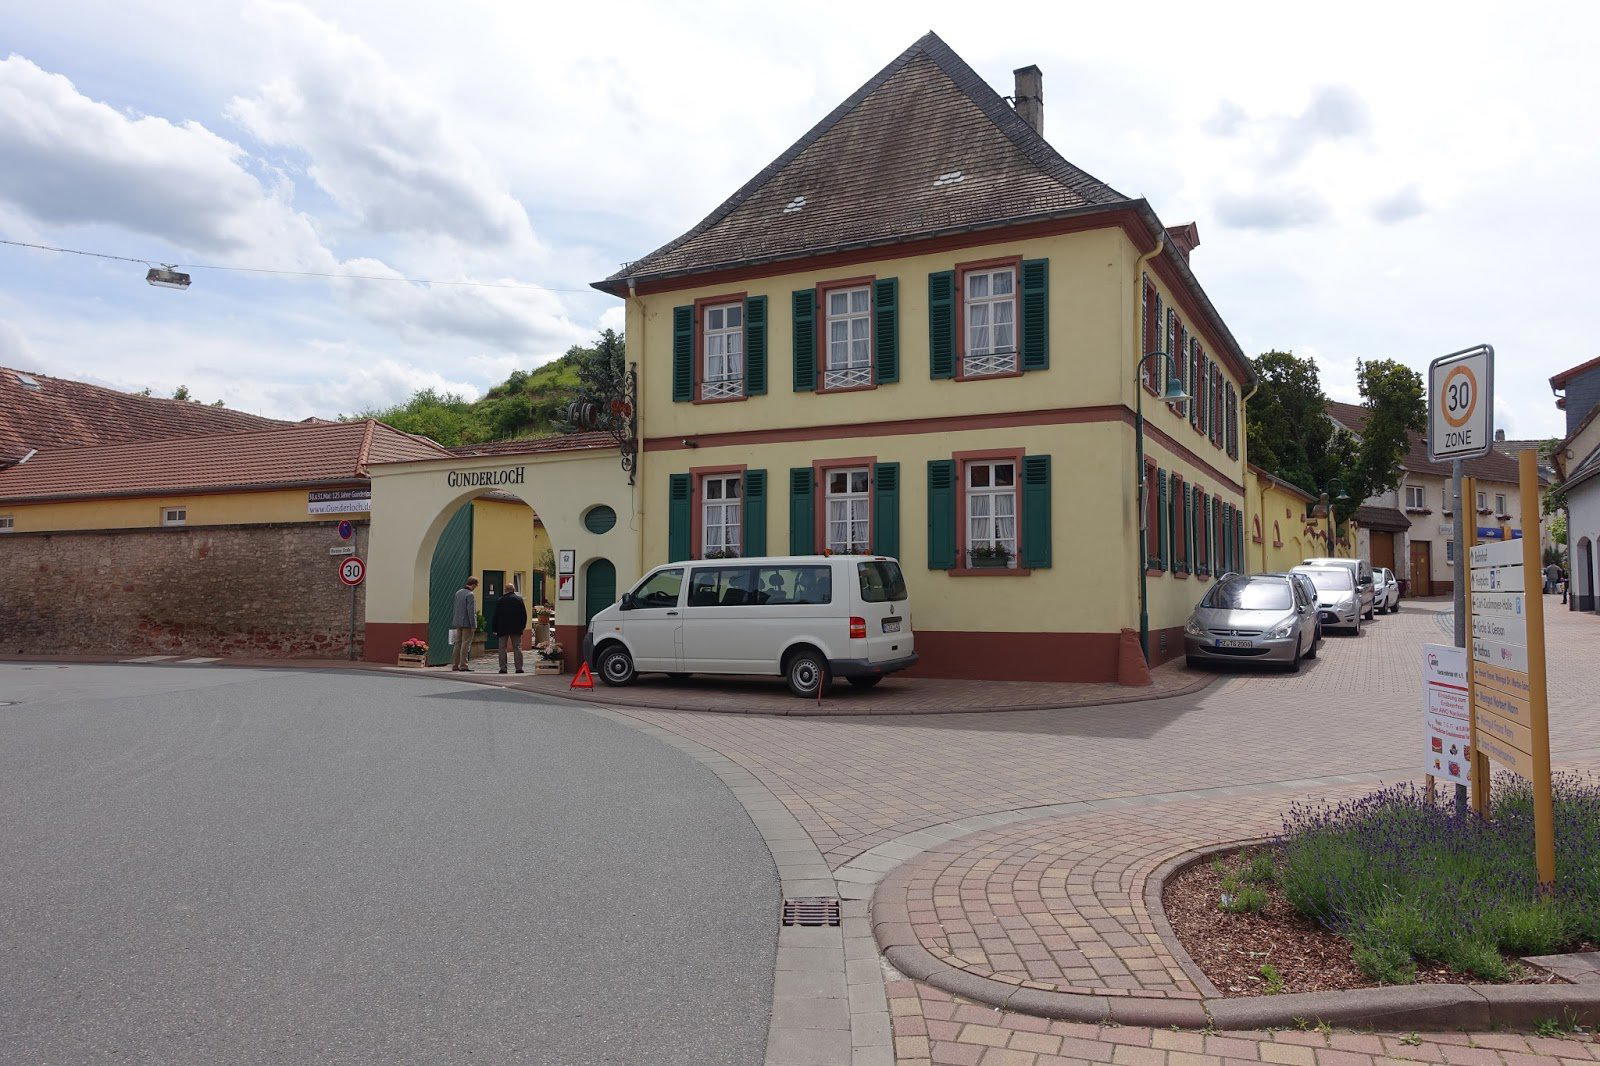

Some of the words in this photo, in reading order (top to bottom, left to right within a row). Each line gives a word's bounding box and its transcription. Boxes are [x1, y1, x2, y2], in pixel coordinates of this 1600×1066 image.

[1448, 381, 1469, 412] 30
[1445, 430, 1472, 448] ZONE
[344, 564, 360, 578] 30
